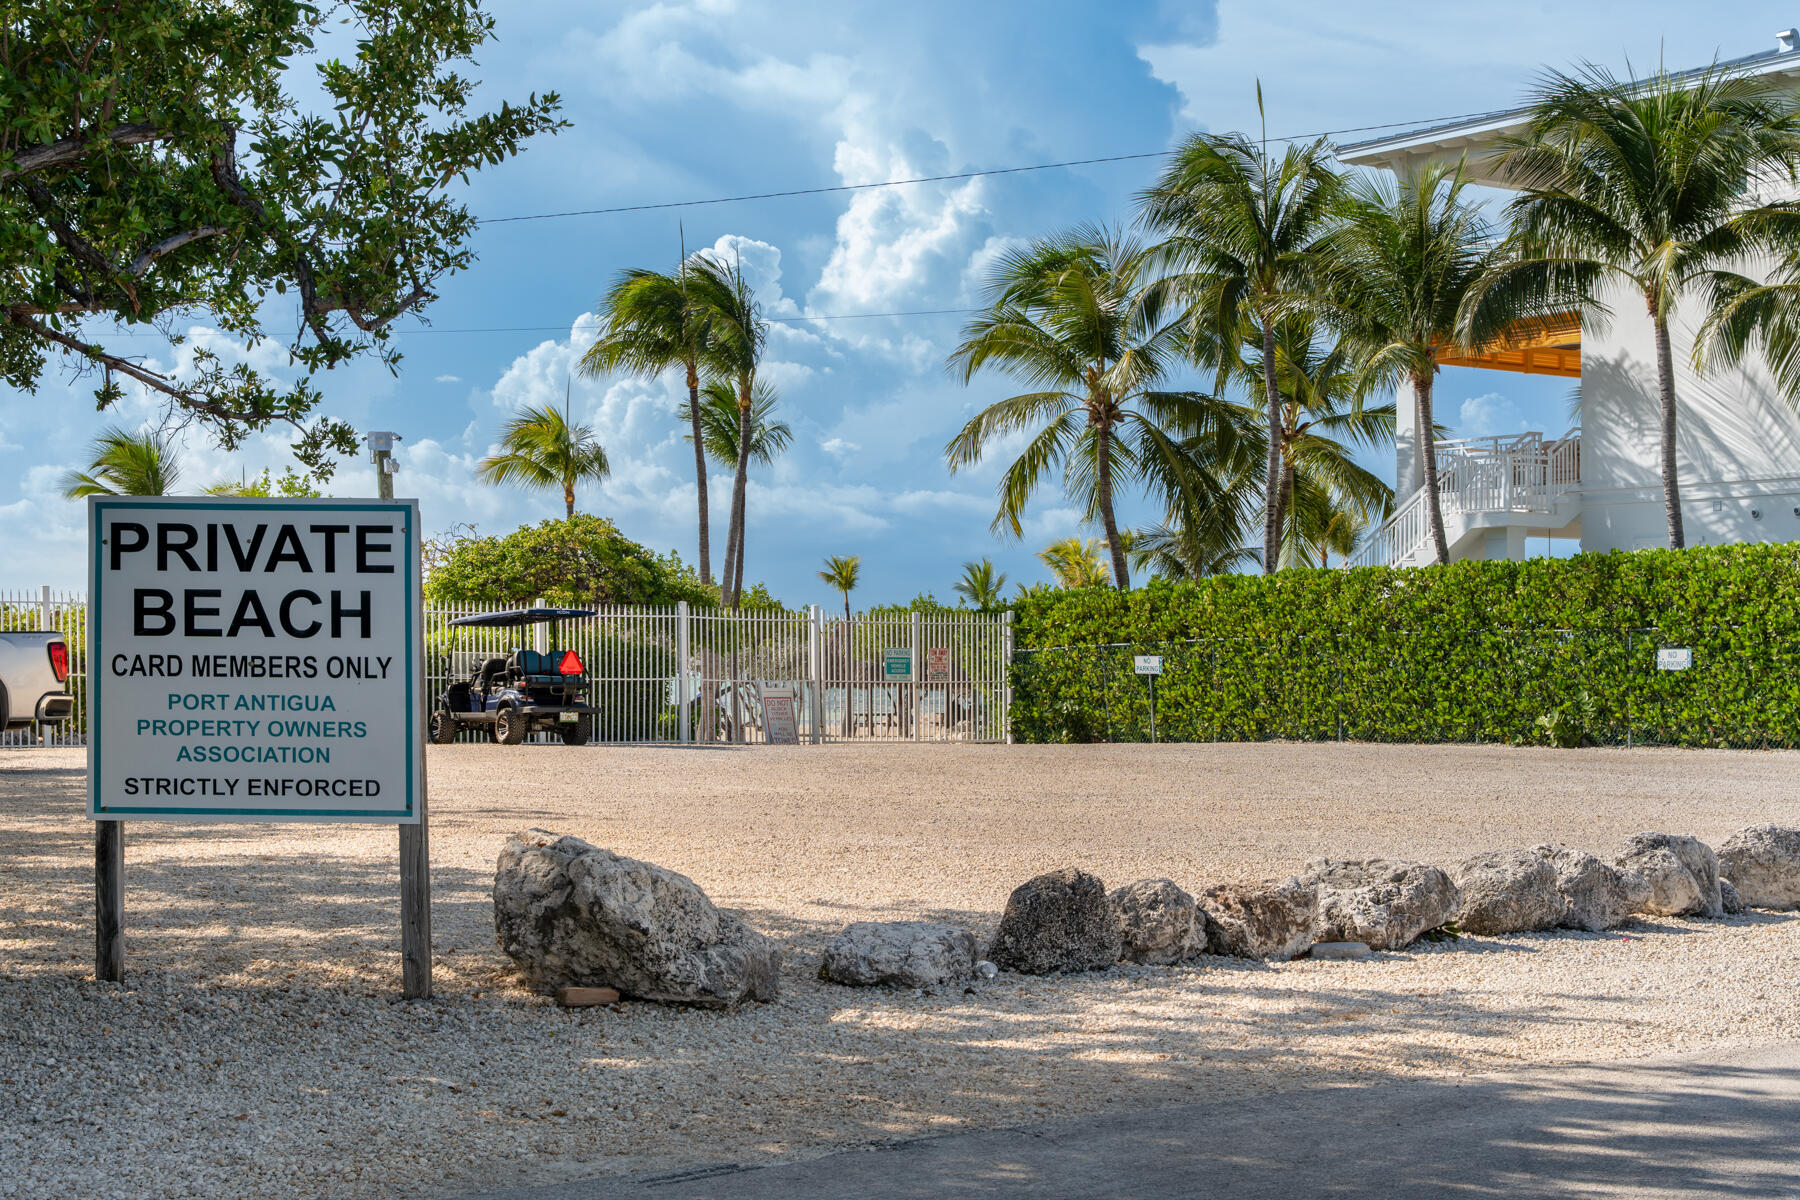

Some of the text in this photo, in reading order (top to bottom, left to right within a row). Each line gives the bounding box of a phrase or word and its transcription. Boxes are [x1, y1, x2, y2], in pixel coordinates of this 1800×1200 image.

[110, 522, 394, 573] PRIVATE
[133, 588, 371, 639] BEACH
[111, 654, 393, 679] CARD MEMBERS ONLY
[1658, 661, 1687, 669] PARKING
[168, 693, 336, 712] PORT ANTIGUA
[137, 719, 367, 738] PROPERTY OWNERS
[176, 745, 330, 763] ASSOCIATION
[124, 777, 381, 797] STRICTLY ENFORCED
